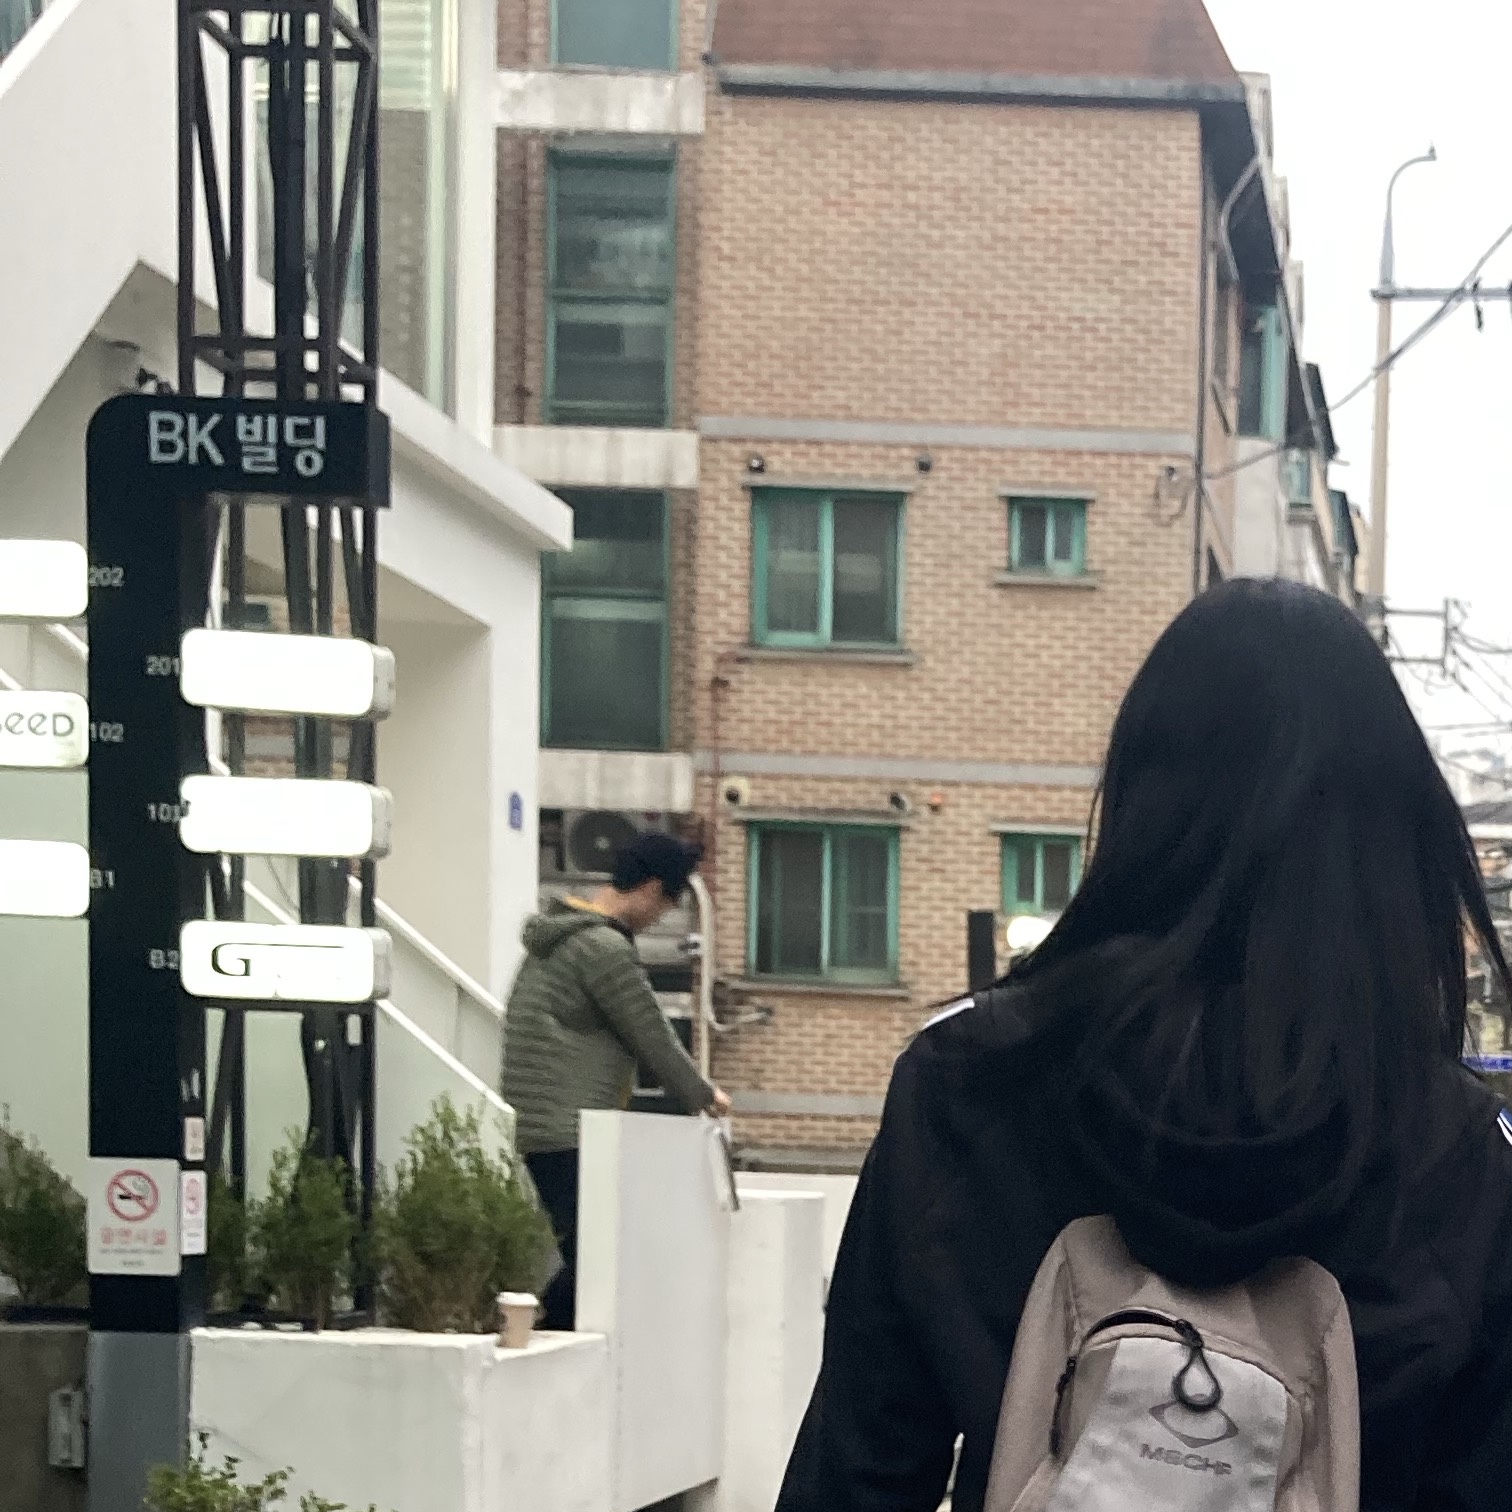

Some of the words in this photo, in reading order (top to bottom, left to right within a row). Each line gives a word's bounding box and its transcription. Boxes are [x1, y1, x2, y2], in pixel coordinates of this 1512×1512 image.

[148, 410, 225, 467] BK
[235, 412, 327, 478] 빌딩
[88, 565, 125, 588] 202
[146, 655, 180, 676] 201
[90, 721, 124, 743] 102
[148, 802, 182, 823] 101
[90, 867, 116, 889] B1
[149, 948, 179, 970] B2
